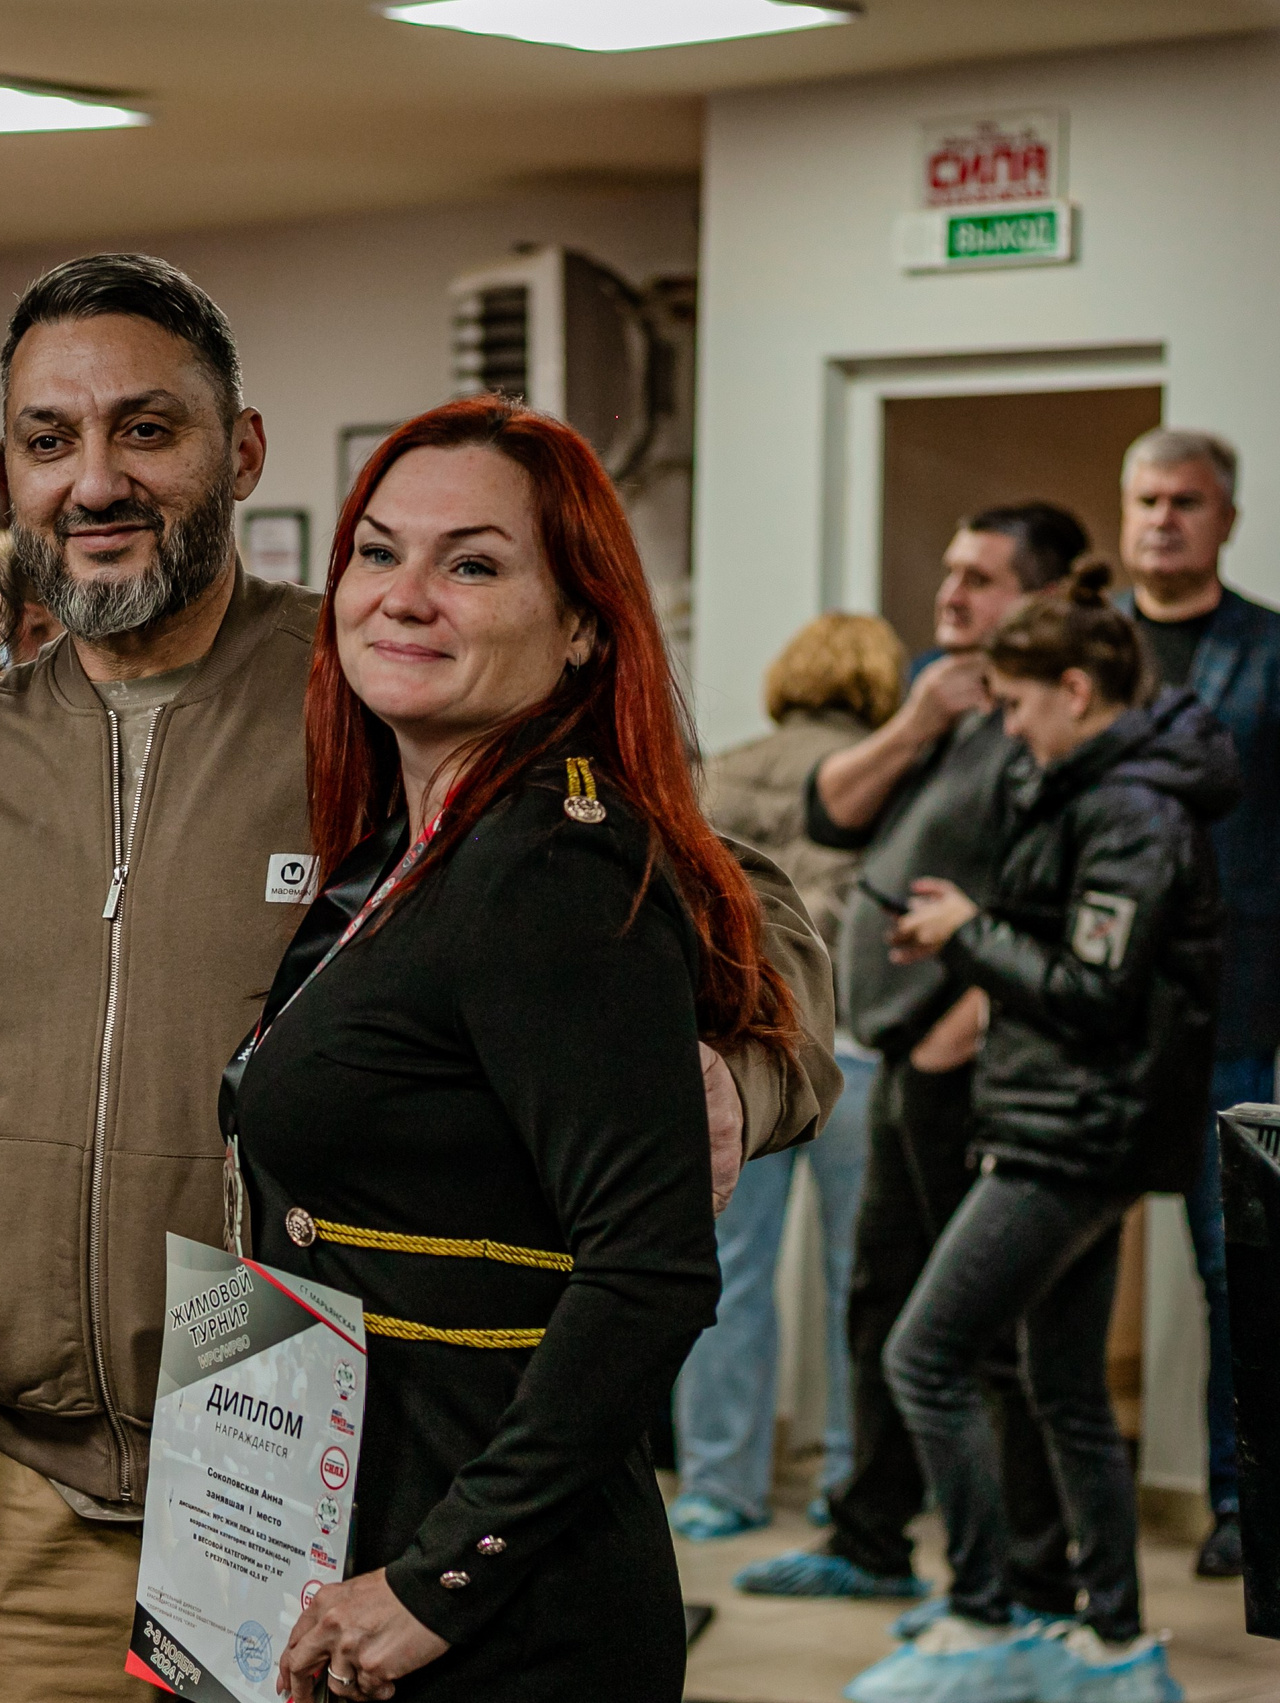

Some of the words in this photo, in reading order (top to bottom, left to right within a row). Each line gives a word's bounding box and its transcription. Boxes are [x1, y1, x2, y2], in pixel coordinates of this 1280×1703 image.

[168, 1265, 255, 1331] ЖИМОВОЙ
[189, 1301, 250, 1348] ТУРНИР
[197, 1334, 251, 1370] WPC/WPSO
[206, 1383, 303, 1439] ДИПЛОМ
[215, 1421, 288, 1459] НАГРАЖДАЕТСЯ
[207, 1467, 259, 1496] Соколовская
[261, 1489, 283, 1506] Анна
[324, 1462, 344, 1478] СИЛА
[206, 1489, 245, 1512] занявшая
[256, 1510, 282, 1527] место
[209, 1552, 248, 1574] РЕЗУЛЬТАТОМ
[224, 1547, 255, 1564] КАТЕГОРИИ
[144, 1621, 161, 1645] 2-3
[160, 1636, 202, 1685] НОЯБРЯ
[150, 1648, 175, 1682] 2024
